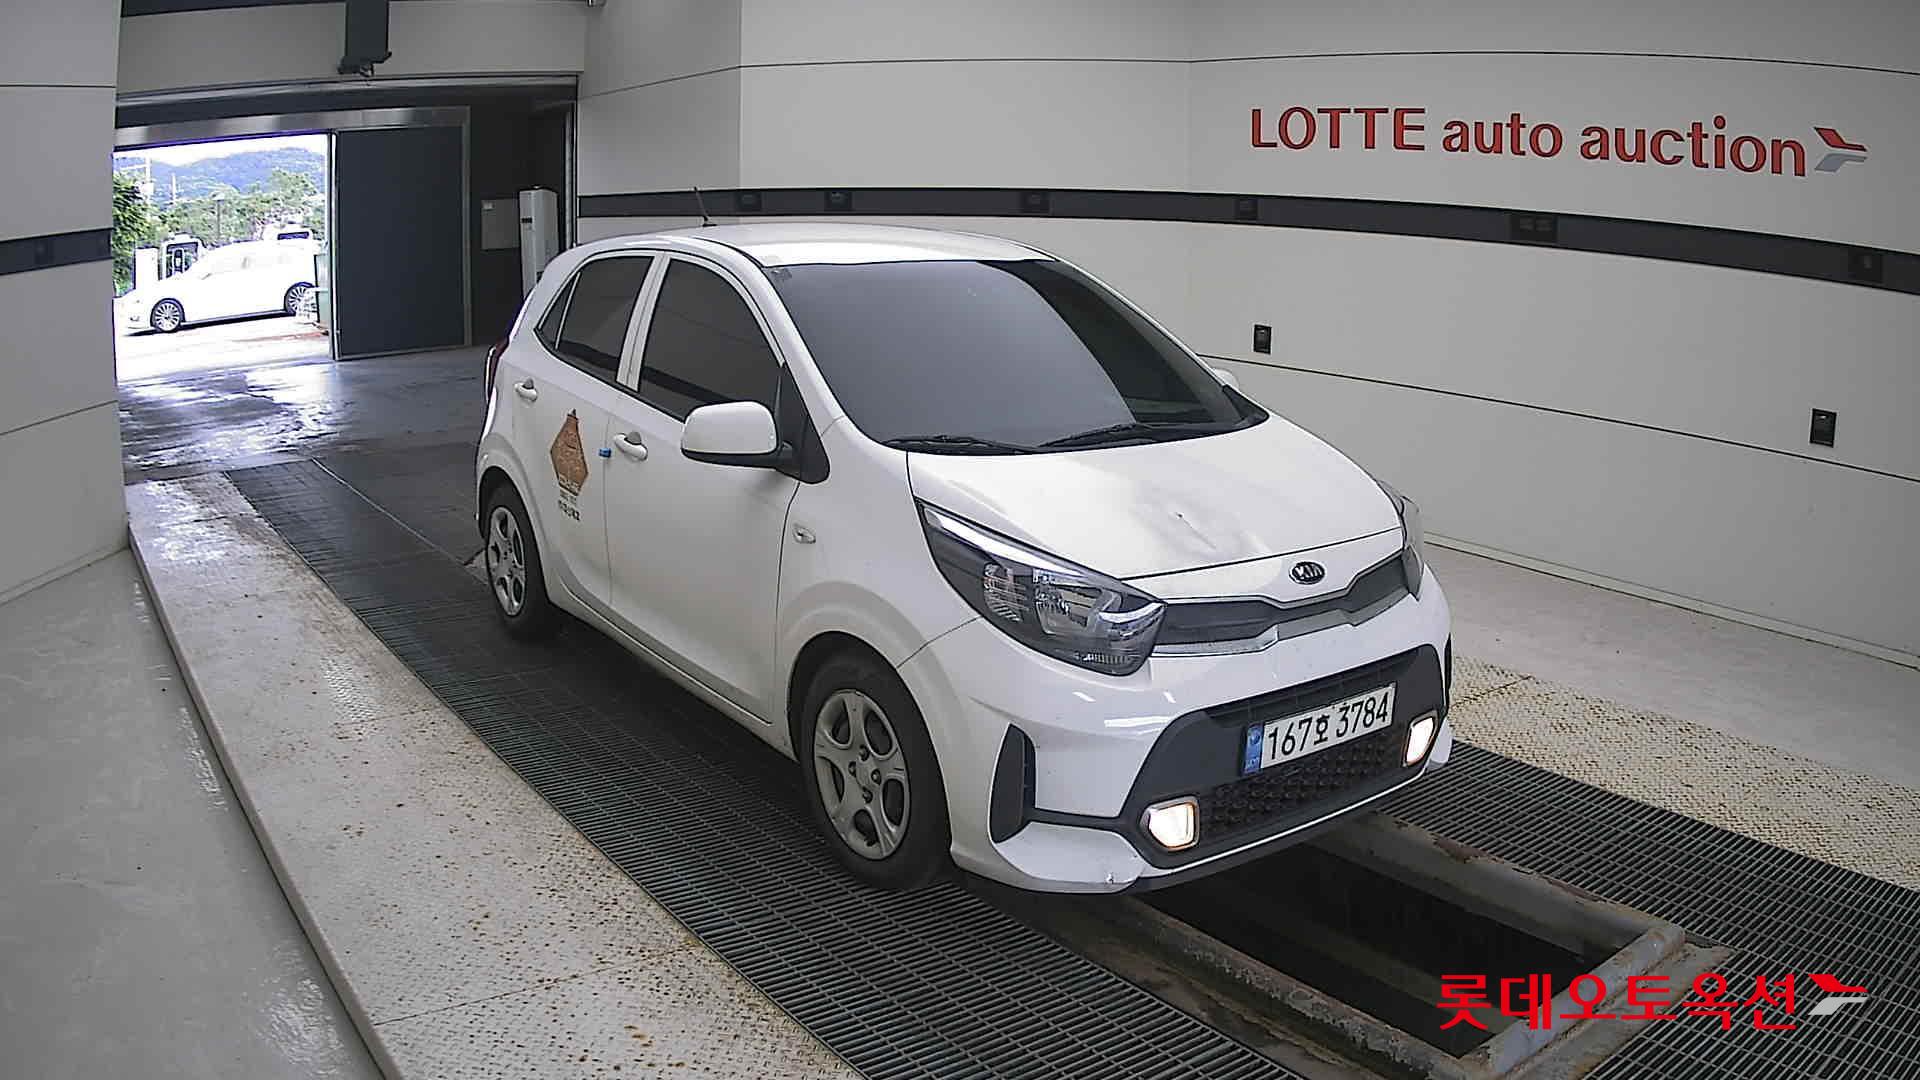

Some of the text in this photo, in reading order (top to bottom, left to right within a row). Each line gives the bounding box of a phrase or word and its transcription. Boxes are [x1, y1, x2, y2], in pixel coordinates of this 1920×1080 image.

[1250, 107, 1807, 177] LOTTE auto auction
[1293, 563, 1324, 581] KIA
[1268, 691, 1389, 760] 167호 3784
